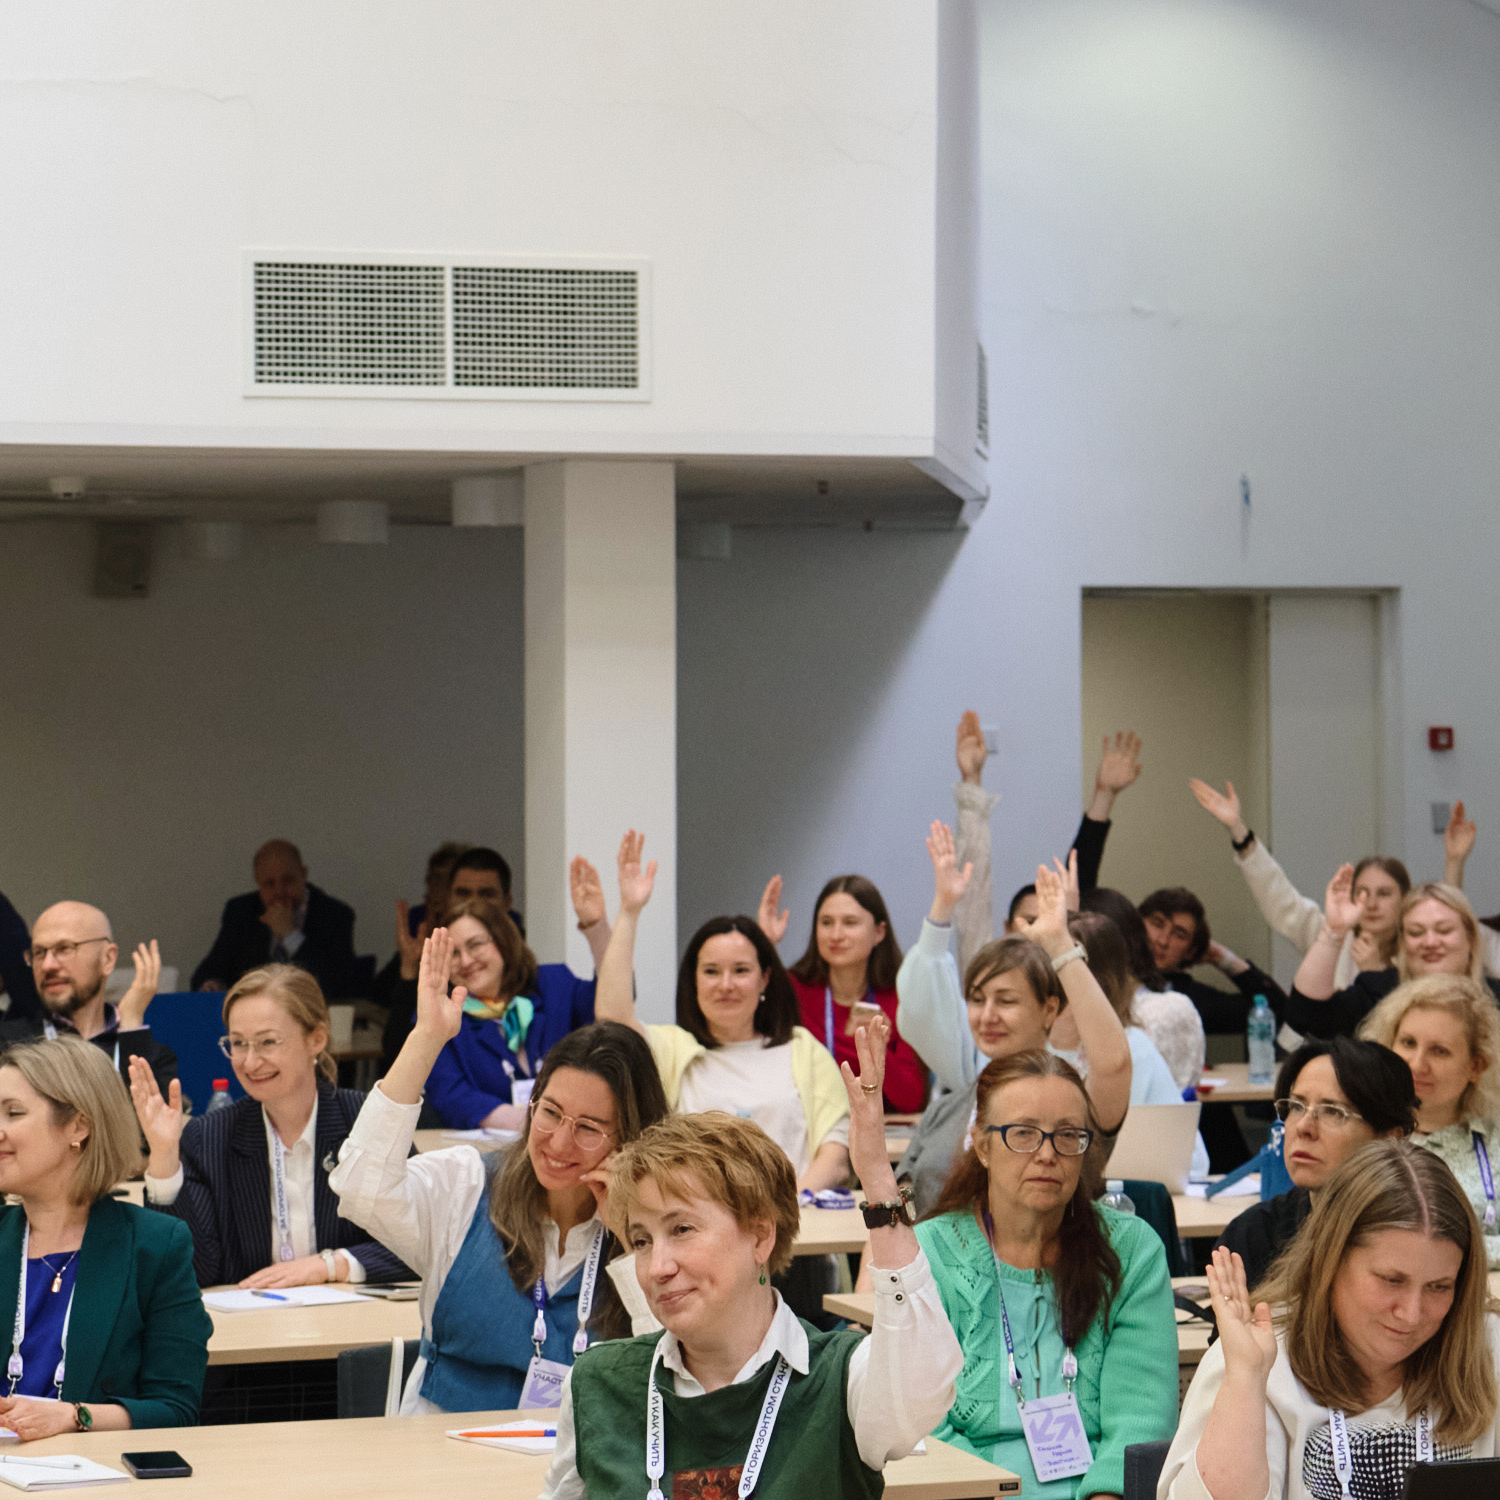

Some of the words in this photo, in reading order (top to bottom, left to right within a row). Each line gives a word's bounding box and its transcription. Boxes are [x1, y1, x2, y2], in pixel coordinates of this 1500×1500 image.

[651, 1395, 659, 1404] И
[651, 1405, 660, 1430] КАК
[651, 1430, 660, 1467] УЧИТЬ
[747, 1396, 777, 1474] ГОРИЗОНТОМ
[1335, 1434, 1347, 1471] УЧИТЬ
[743, 1475, 753, 1492] ЗА
